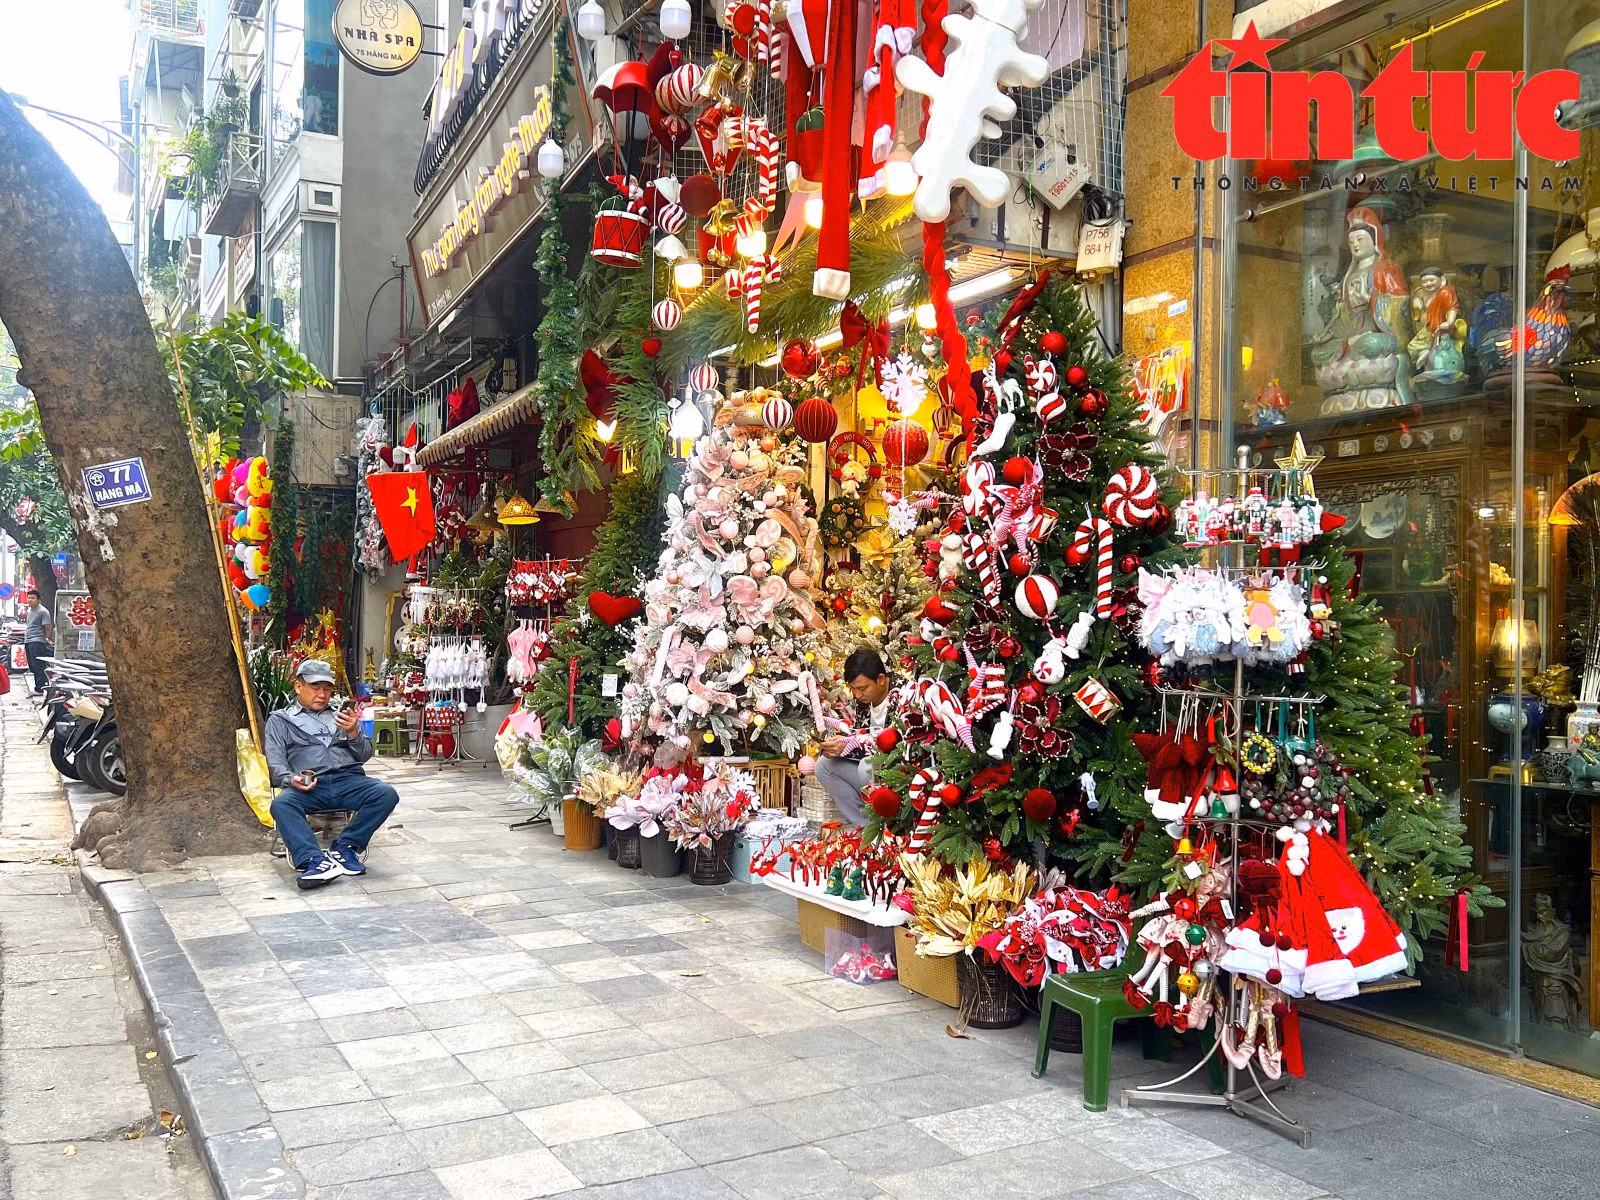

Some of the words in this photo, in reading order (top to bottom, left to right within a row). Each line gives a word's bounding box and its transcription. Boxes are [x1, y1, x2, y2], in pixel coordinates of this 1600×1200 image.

[344, 27, 378, 41] NHÀ
[384, 34, 415, 46] SPA
[109, 465, 130, 484] 77
[95, 487, 124, 502] HÀNG
[124, 481, 143, 496] MÃ
